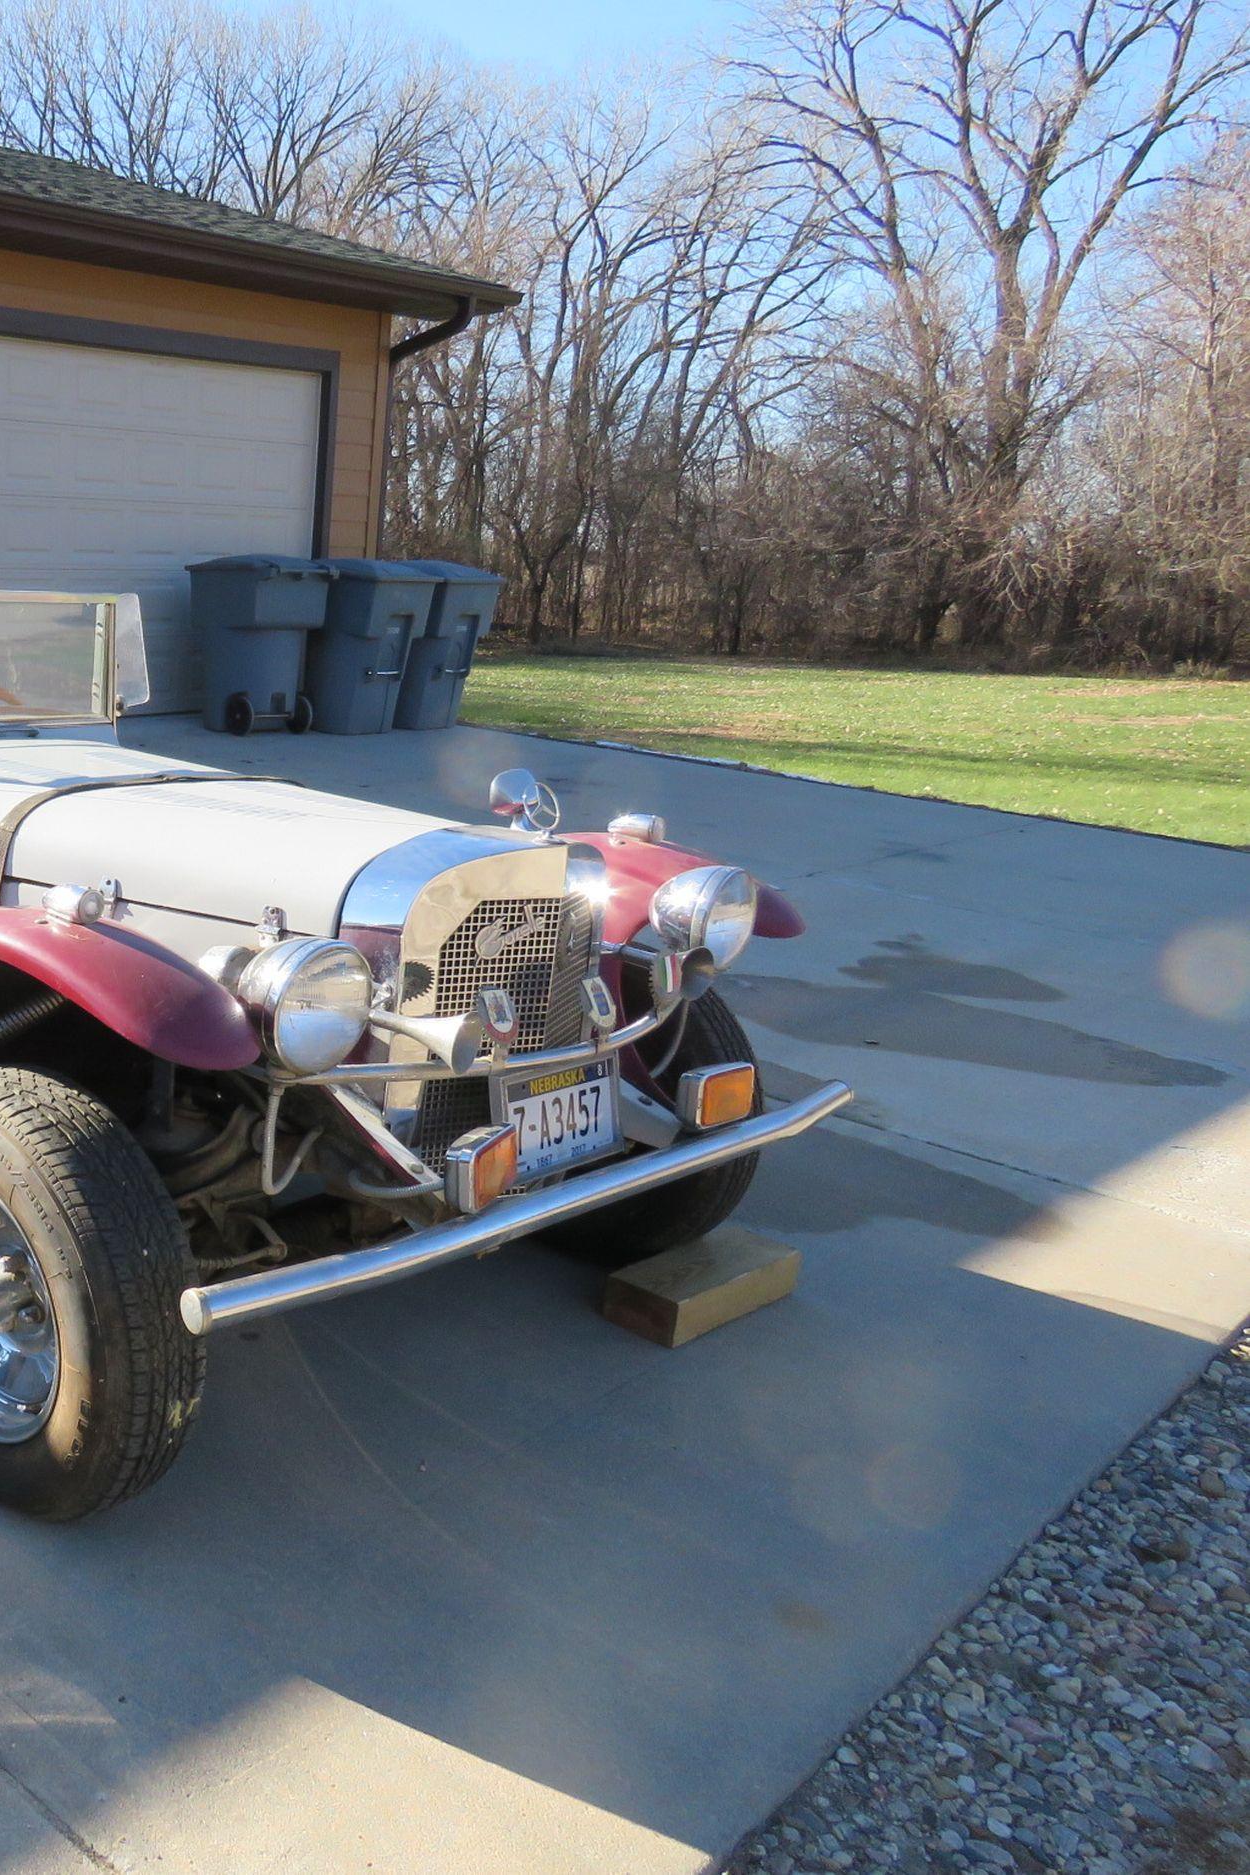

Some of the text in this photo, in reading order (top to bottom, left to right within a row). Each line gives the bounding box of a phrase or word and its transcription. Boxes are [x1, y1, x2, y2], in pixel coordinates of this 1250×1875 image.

[530, 1067, 586, 1096] NEBRASKA
[513, 1085, 601, 1156] 7-A3457
[571, 1143, 586, 1158] 2017
